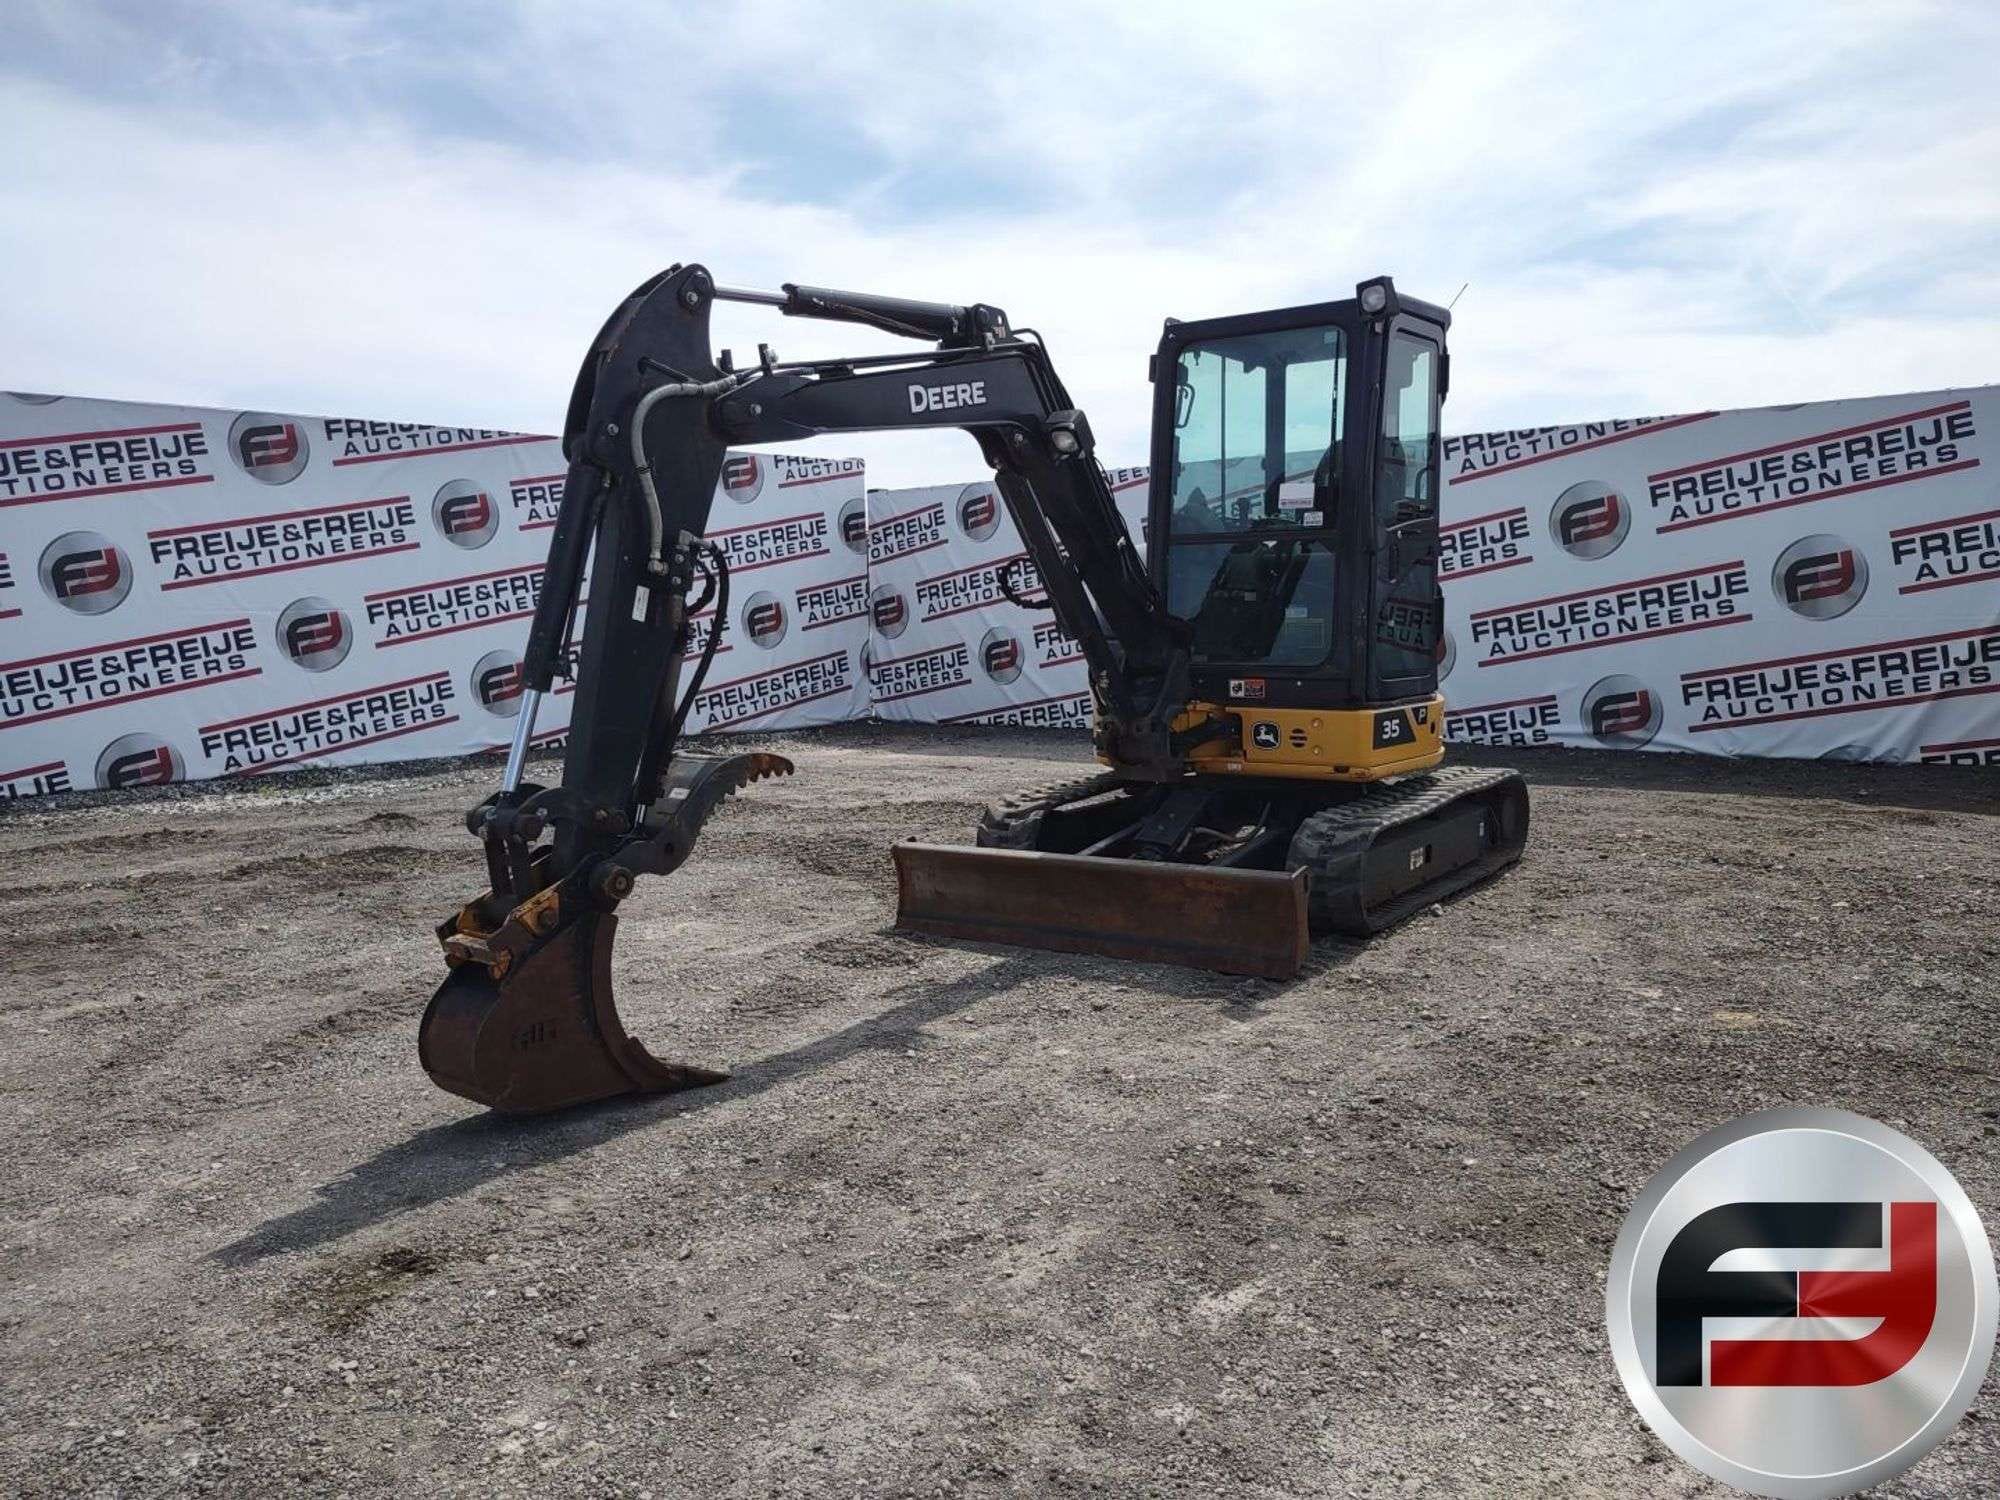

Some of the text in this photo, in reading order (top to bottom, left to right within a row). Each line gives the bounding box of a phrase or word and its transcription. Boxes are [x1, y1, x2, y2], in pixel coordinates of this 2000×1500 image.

[908, 381, 987, 414] DEERE
[1669, 442, 1959, 522] AUCTIONEERS
[173, 528, 406, 581] AUCTIONEERS
[1892, 523, 2000, 565] FREI
[1489, 598, 1736, 657] AUCTIONEERS
[3, 653, 247, 717] UCTIONEERS
[707, 674, 845, 726] AUCTIONEERS
[1702, 666, 1992, 722] AUCTIONEERS
[224, 703, 446, 772] AUCTIONEERS
[1382, 719, 1400, 740] 35
